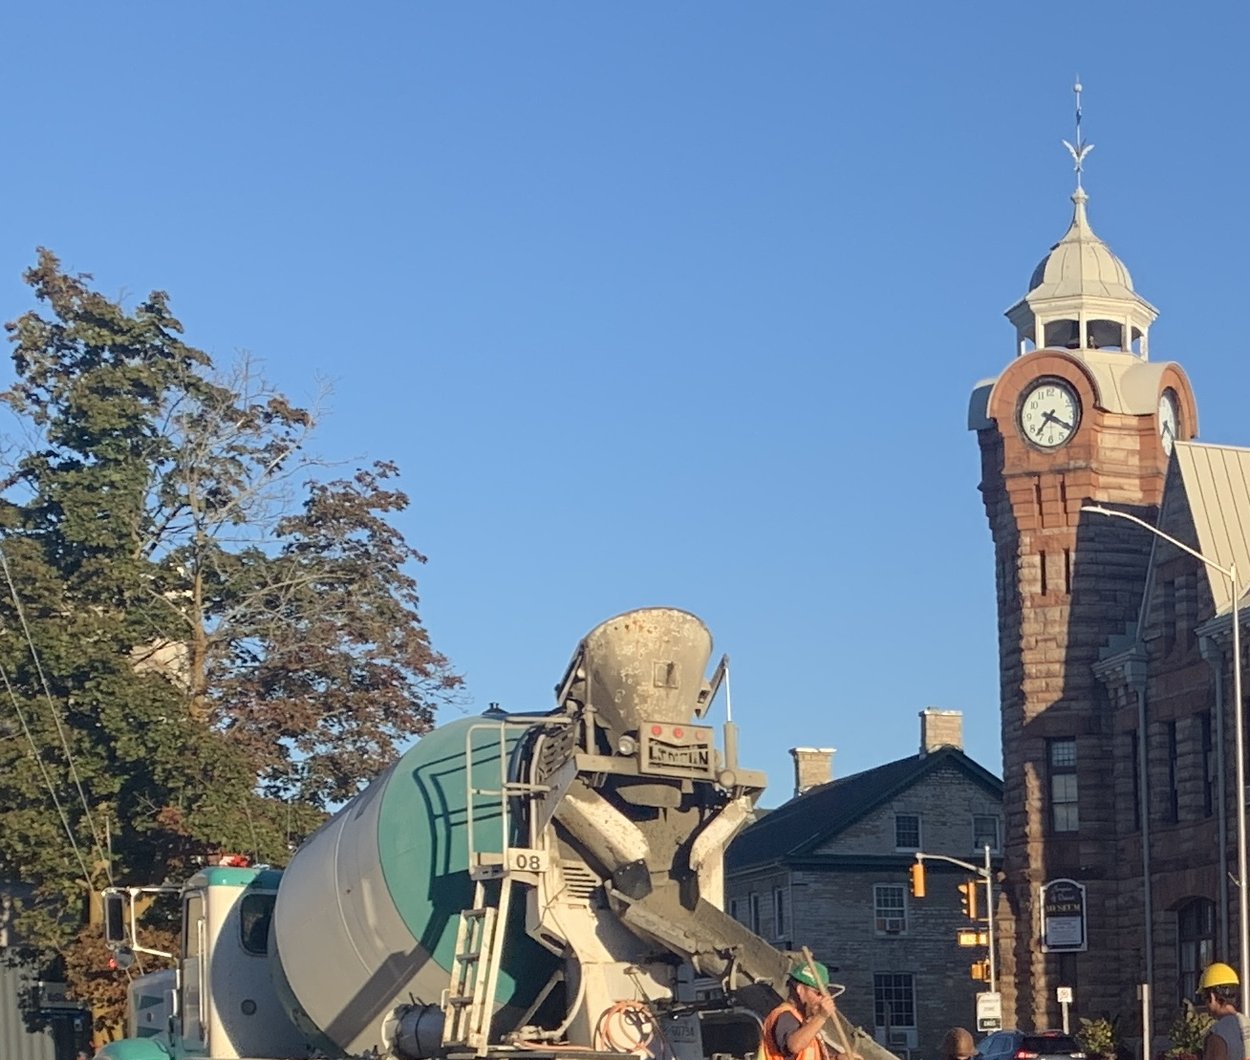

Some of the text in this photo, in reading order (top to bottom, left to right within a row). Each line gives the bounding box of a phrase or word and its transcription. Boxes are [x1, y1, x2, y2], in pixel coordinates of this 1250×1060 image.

[1038, 391, 1044, 400] 11
[1046, 388, 1055, 397] 12
[1031, 401, 1039, 409] 10
[1026, 413, 1032, 421] 9
[1030, 425, 1035, 433] 8
[1048, 435, 1053, 444] 6
[516, 854, 540, 870] 08
